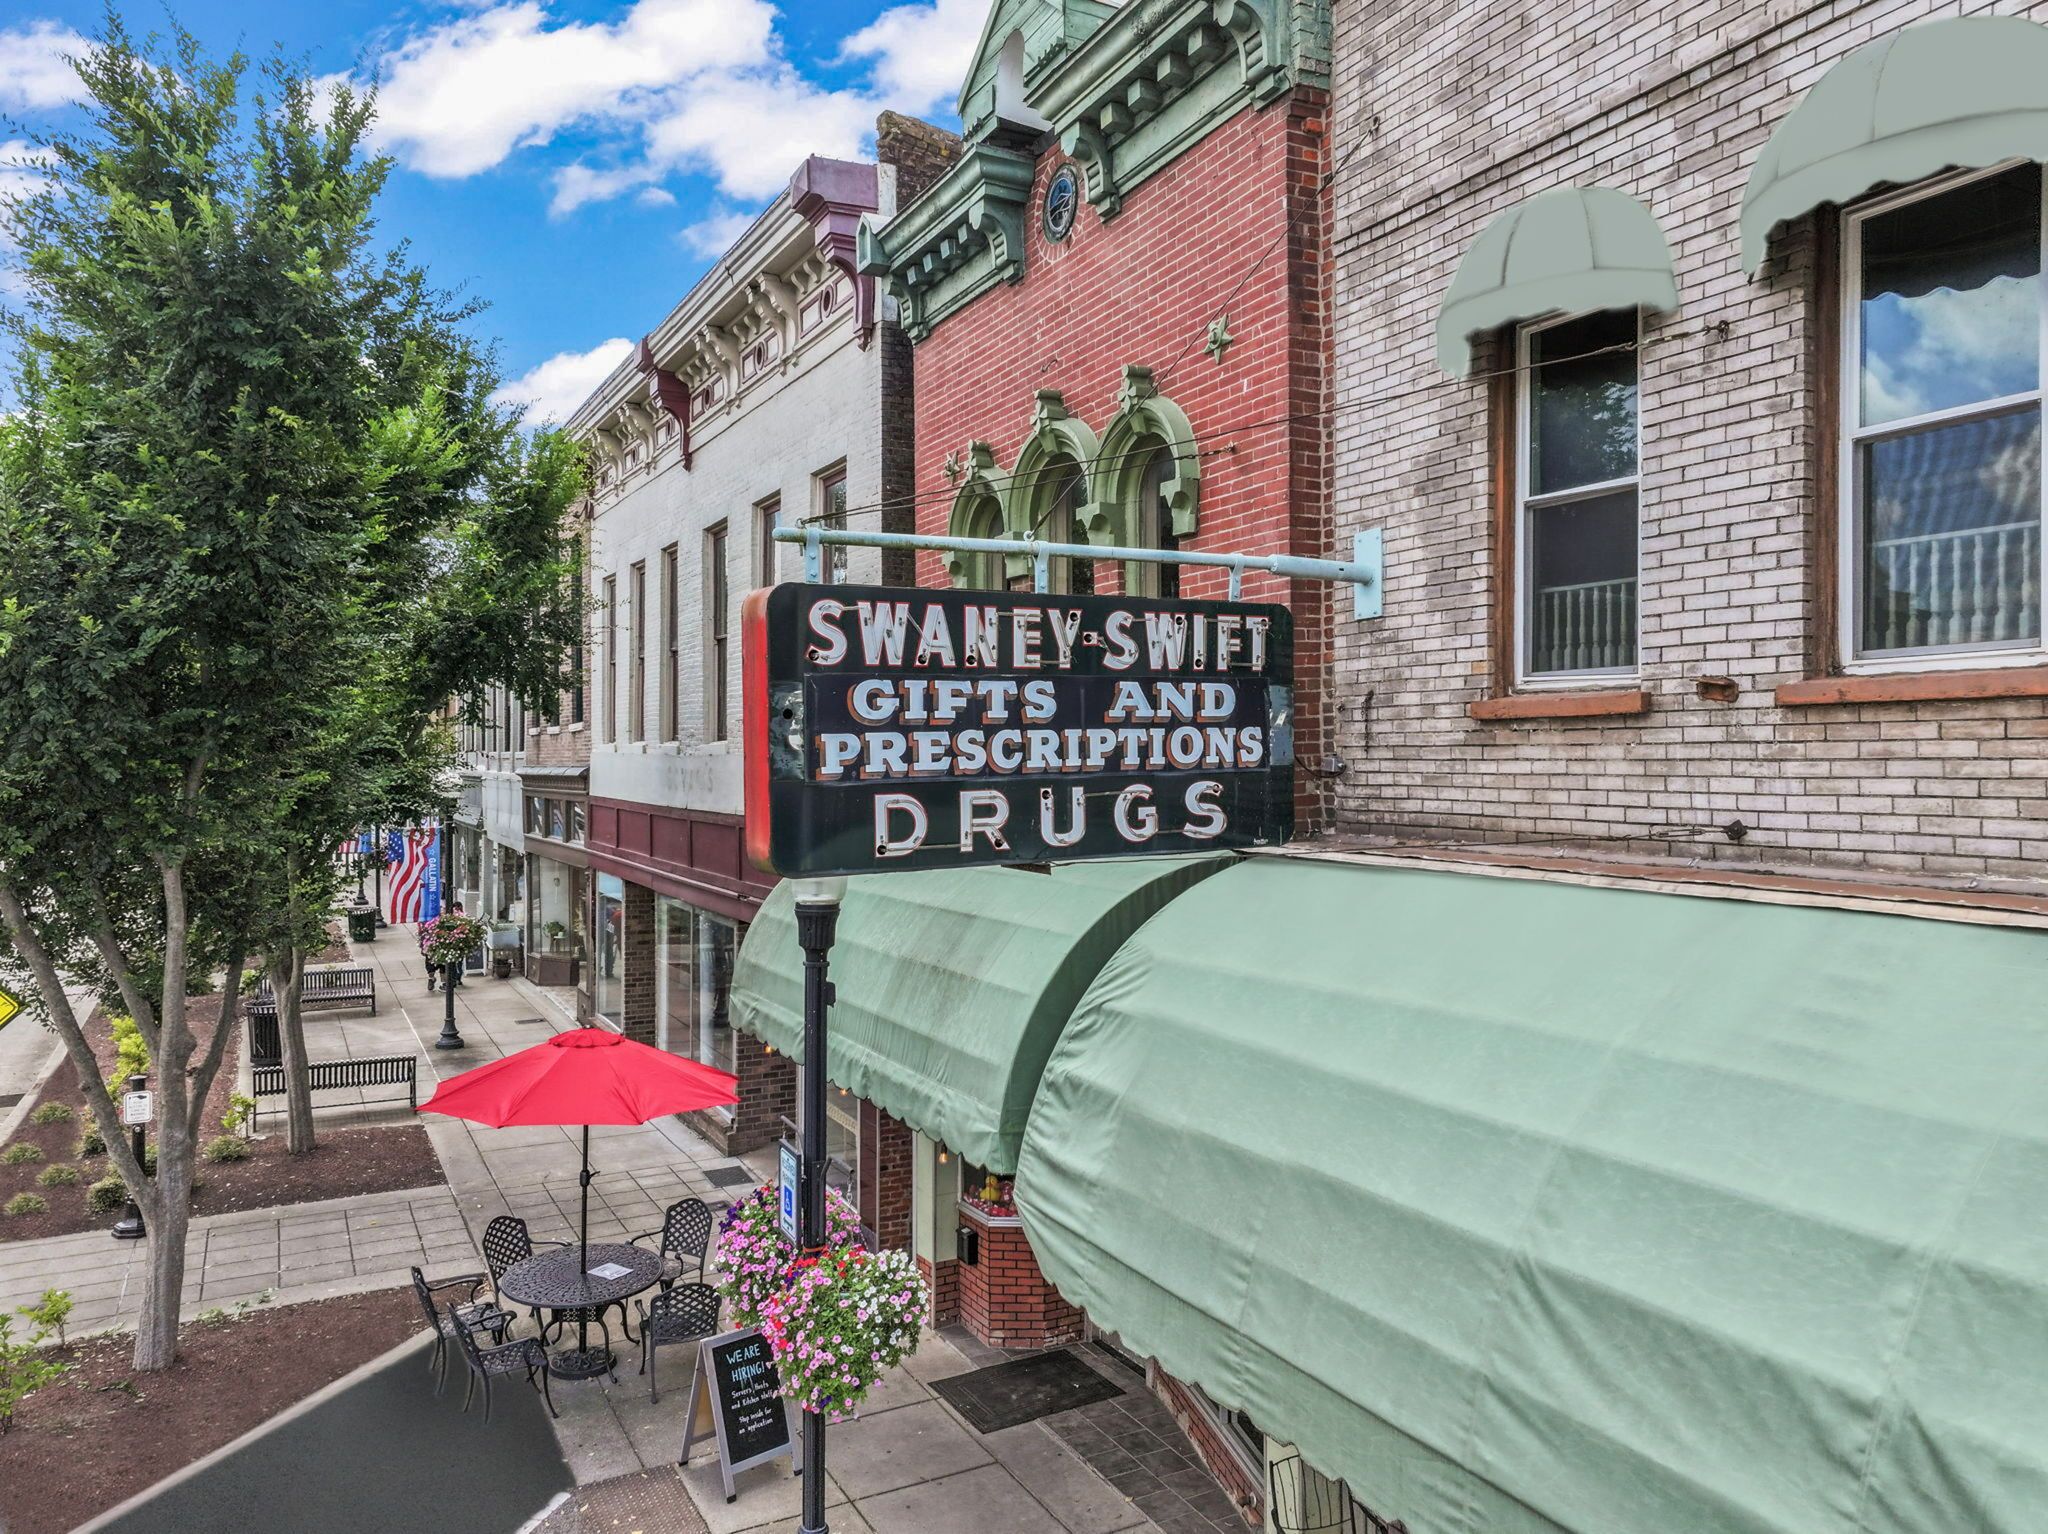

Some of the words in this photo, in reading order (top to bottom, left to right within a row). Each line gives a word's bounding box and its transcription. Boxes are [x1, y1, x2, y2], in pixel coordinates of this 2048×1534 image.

[848, 679, 1056, 725] GIFTS
[1105, 681, 1237, 722] AND
[815, 726, 1264, 780] PRESCRIPTIONS
[874, 780, 1228, 858] DRUGS
[429, 857, 437, 892] GALLATIN
[726, 1350, 743, 1365] WE
[744, 1343, 761, 1360] ARE
[731, 1361, 765, 1382] HIRING!
